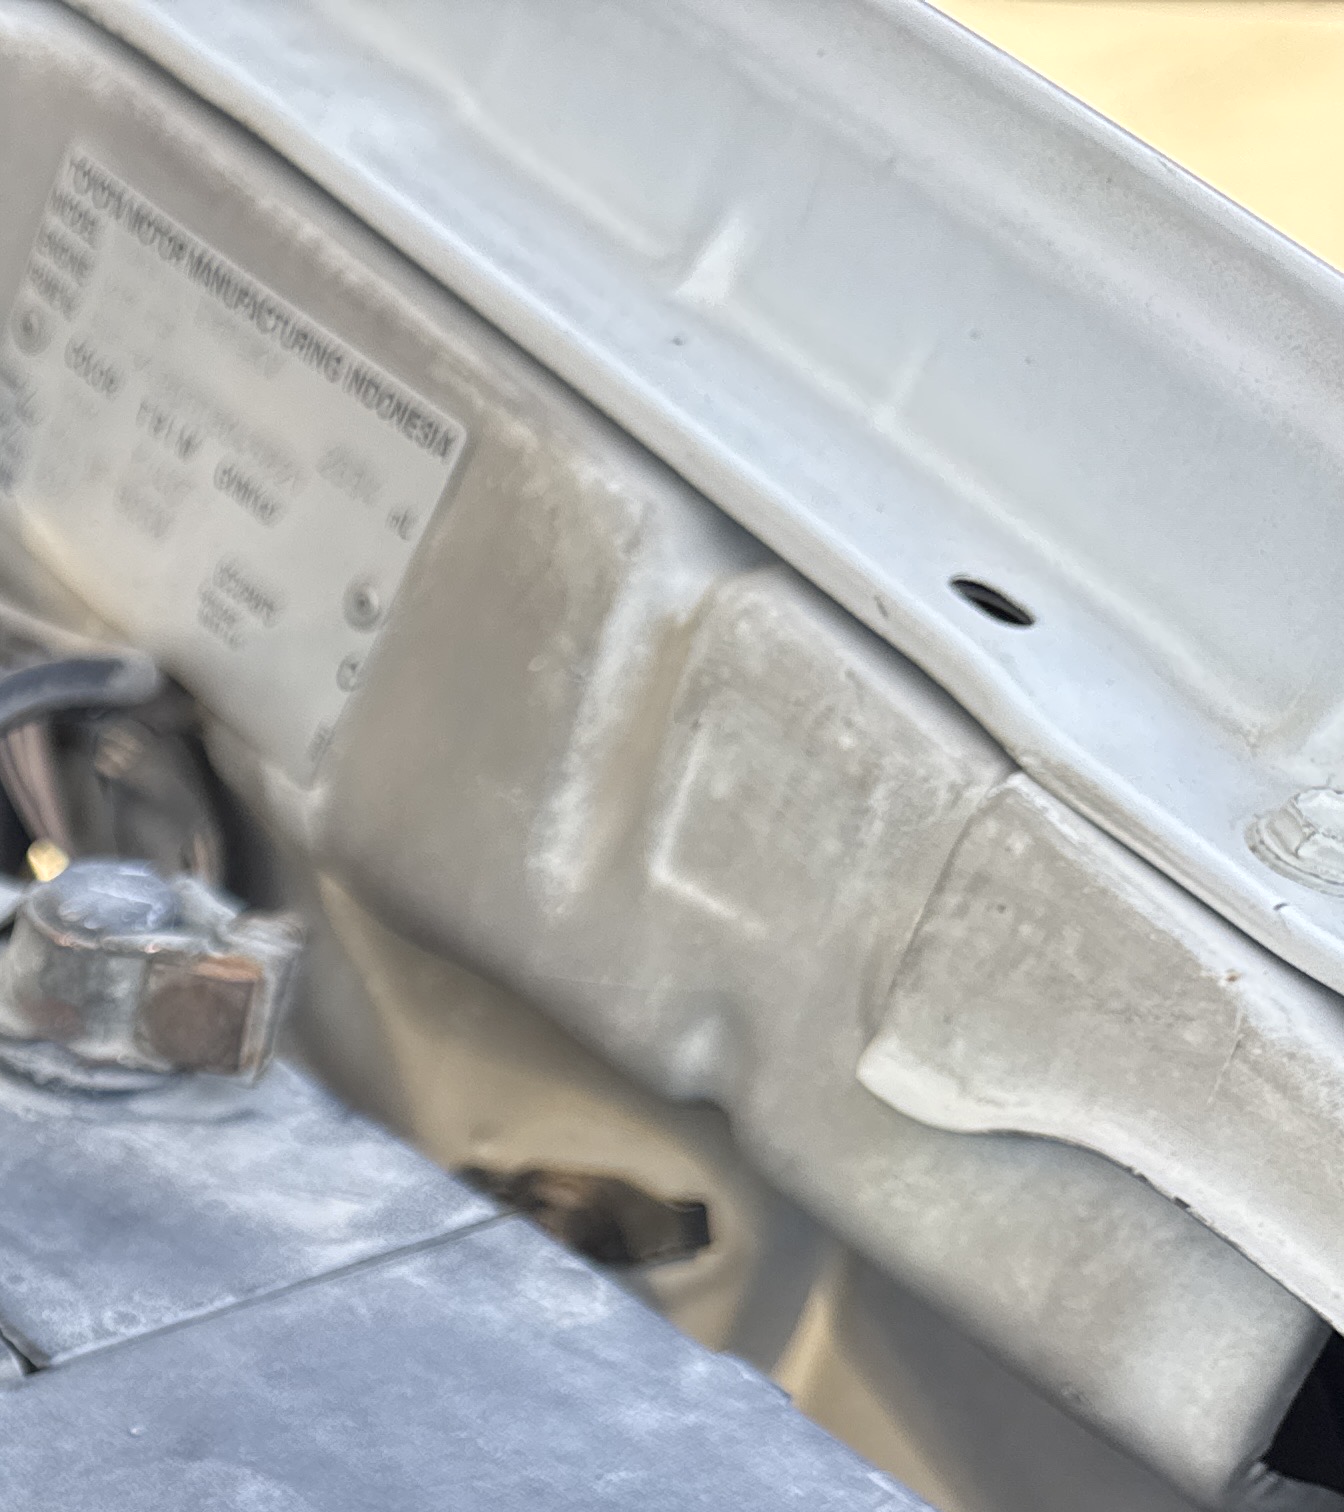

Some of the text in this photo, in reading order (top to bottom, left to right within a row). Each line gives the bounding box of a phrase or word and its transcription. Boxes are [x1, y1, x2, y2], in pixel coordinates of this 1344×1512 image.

[124, 196, 190, 266] MOTOR
[185, 245, 344, 384] MANUFACTURING
[340, 362, 458, 464] INDONESIA
